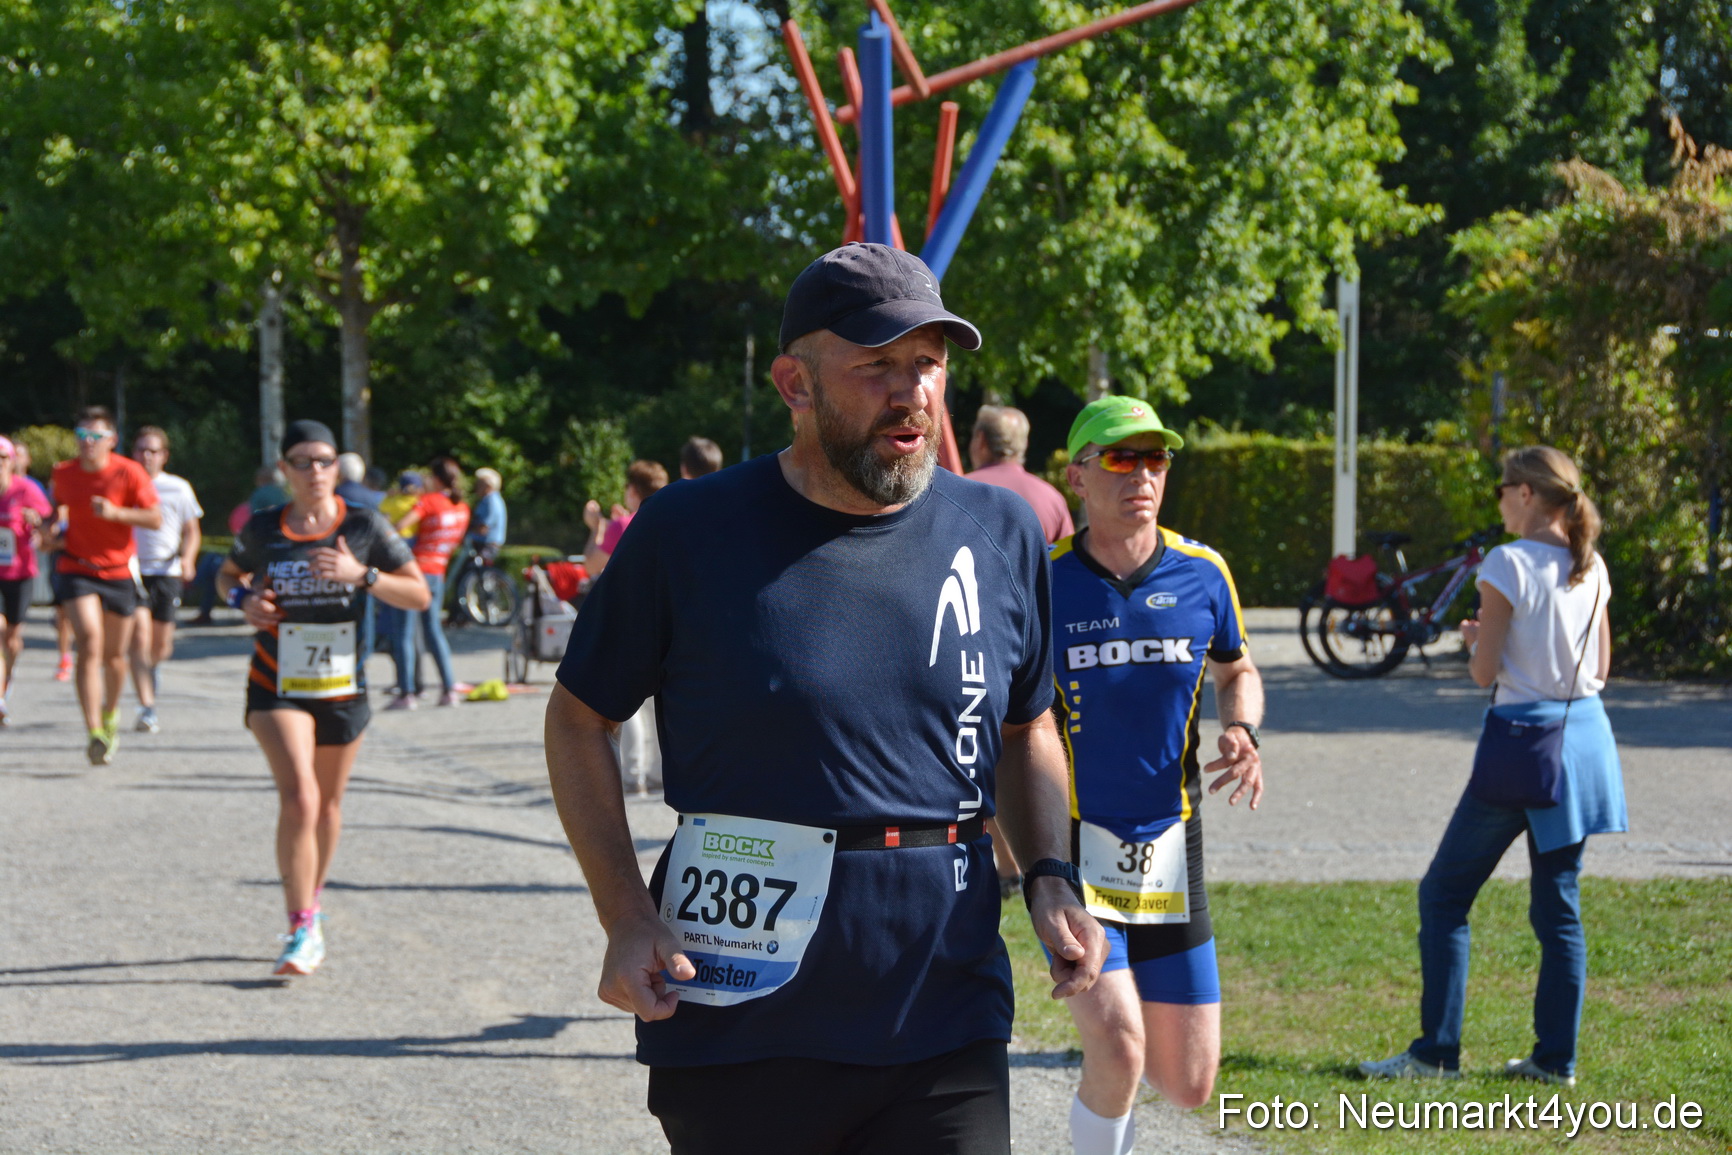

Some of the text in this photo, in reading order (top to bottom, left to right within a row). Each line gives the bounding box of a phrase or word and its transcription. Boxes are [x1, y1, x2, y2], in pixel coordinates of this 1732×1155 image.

[1065, 617, 1120, 634] TEAM
[304, 645, 331, 667] 74
[1066, 638, 1194, 671] BOCK
[702, 831, 776, 860] BOCK
[701, 852, 721, 861] inspired
[721, 854, 729, 862] by
[746, 858, 775, 867] concepts
[1117, 841, 1155, 875] 38
[1100, 875, 1125, 886] PARTL
[677, 866, 798, 932] 2387
[1094, 889, 1169, 910] Franz Xaver
[684, 932, 763, 952] PARTL Neumarkt
[693, 958, 757, 988] Torsten
